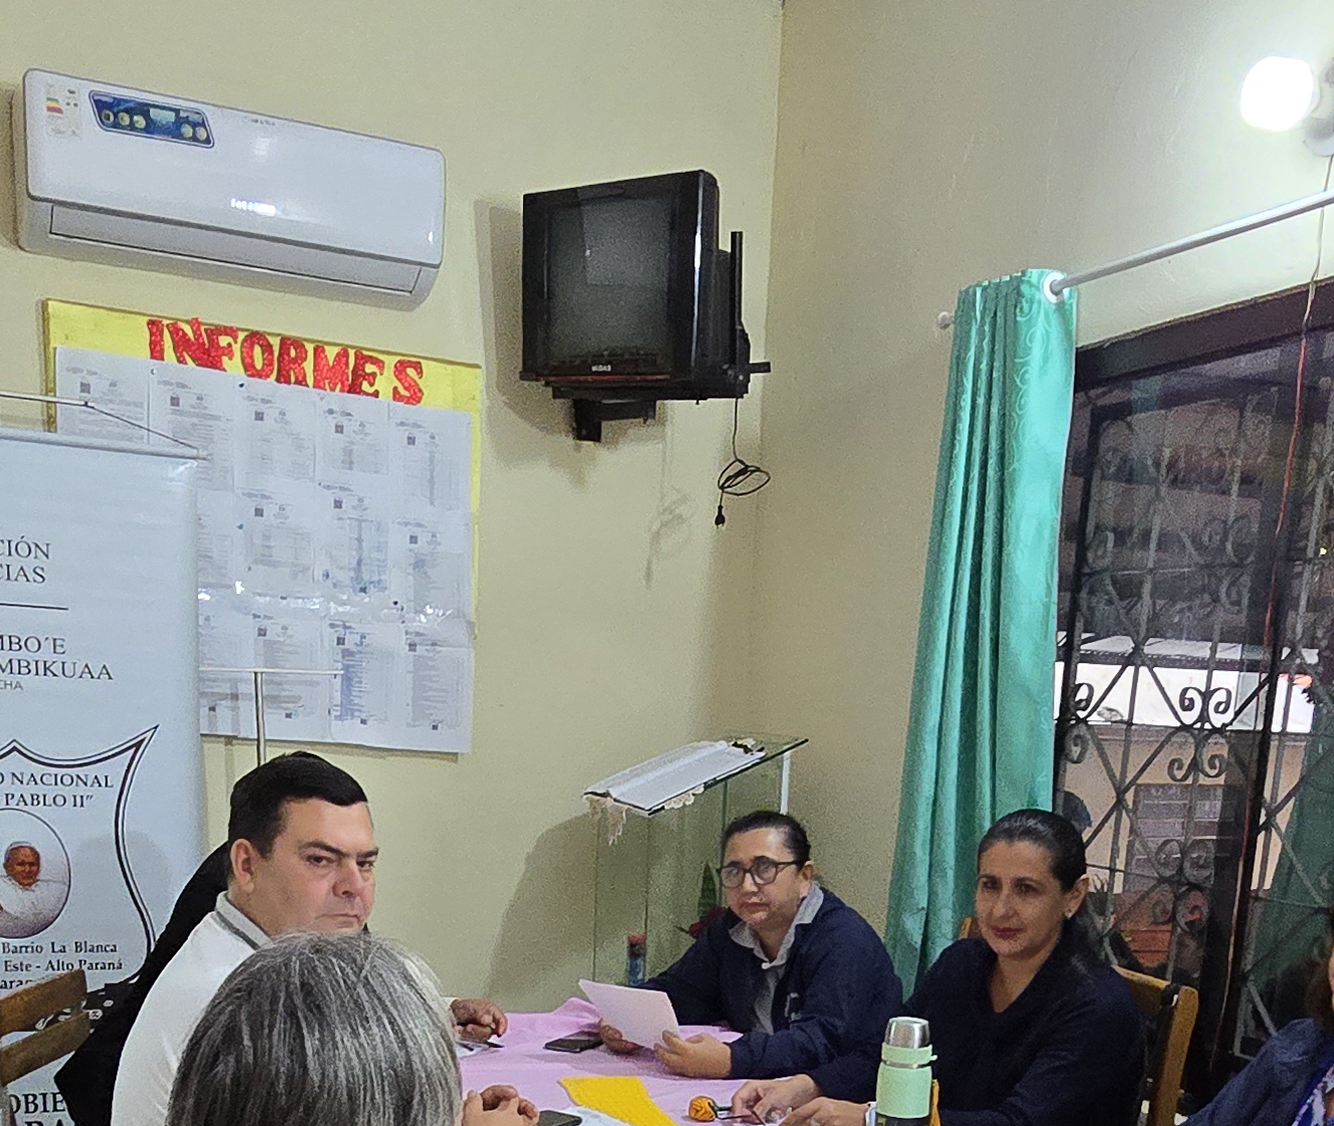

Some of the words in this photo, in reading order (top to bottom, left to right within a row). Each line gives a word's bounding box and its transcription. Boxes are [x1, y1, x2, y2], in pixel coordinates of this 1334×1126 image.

[147, 317, 424, 406] INFORMES
[10, 771, 114, 788] NACIONAL
[5, 793, 66, 808] PABLO
[2, 942, 43, 954] Barrio
[51, 941, 66, 954] La
[74, 941, 117, 954] Blanca
[4, 960, 32, 973] Este
[45, 960, 74, 972] Alto
[78, 958, 123, 971] Paraná
